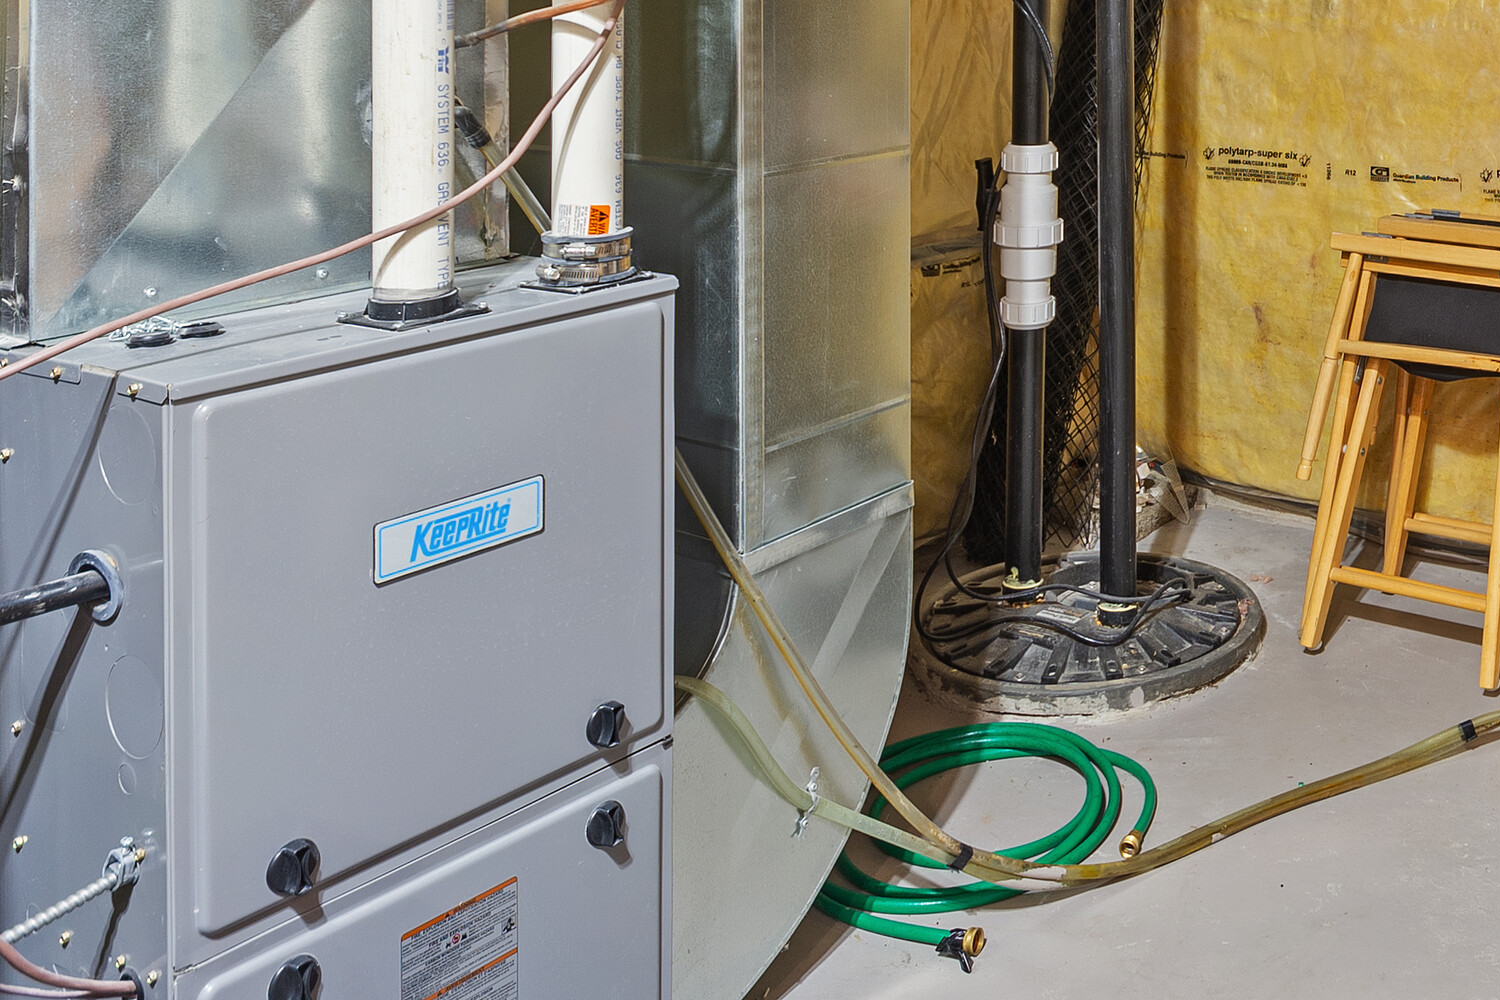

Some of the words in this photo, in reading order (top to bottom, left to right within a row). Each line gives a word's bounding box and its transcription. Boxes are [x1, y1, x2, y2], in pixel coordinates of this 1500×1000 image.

[614, 16, 623, 50] CLASS
[614, 75, 623, 102] TYPE
[437, 84, 449, 134] SYSTEM
[614, 108, 623, 134] VENT
[614, 140, 623, 160] GAS
[1218, 146, 1283, 159] polytarp-super
[1285, 150, 1298, 160] six
[1392, 172, 1415, 180] Guardian
[1415, 174, 1436, 182] Building
[1437, 175, 1459, 183] Products
[437, 216, 449, 247] VENT
[437, 259, 449, 290] TYPE
